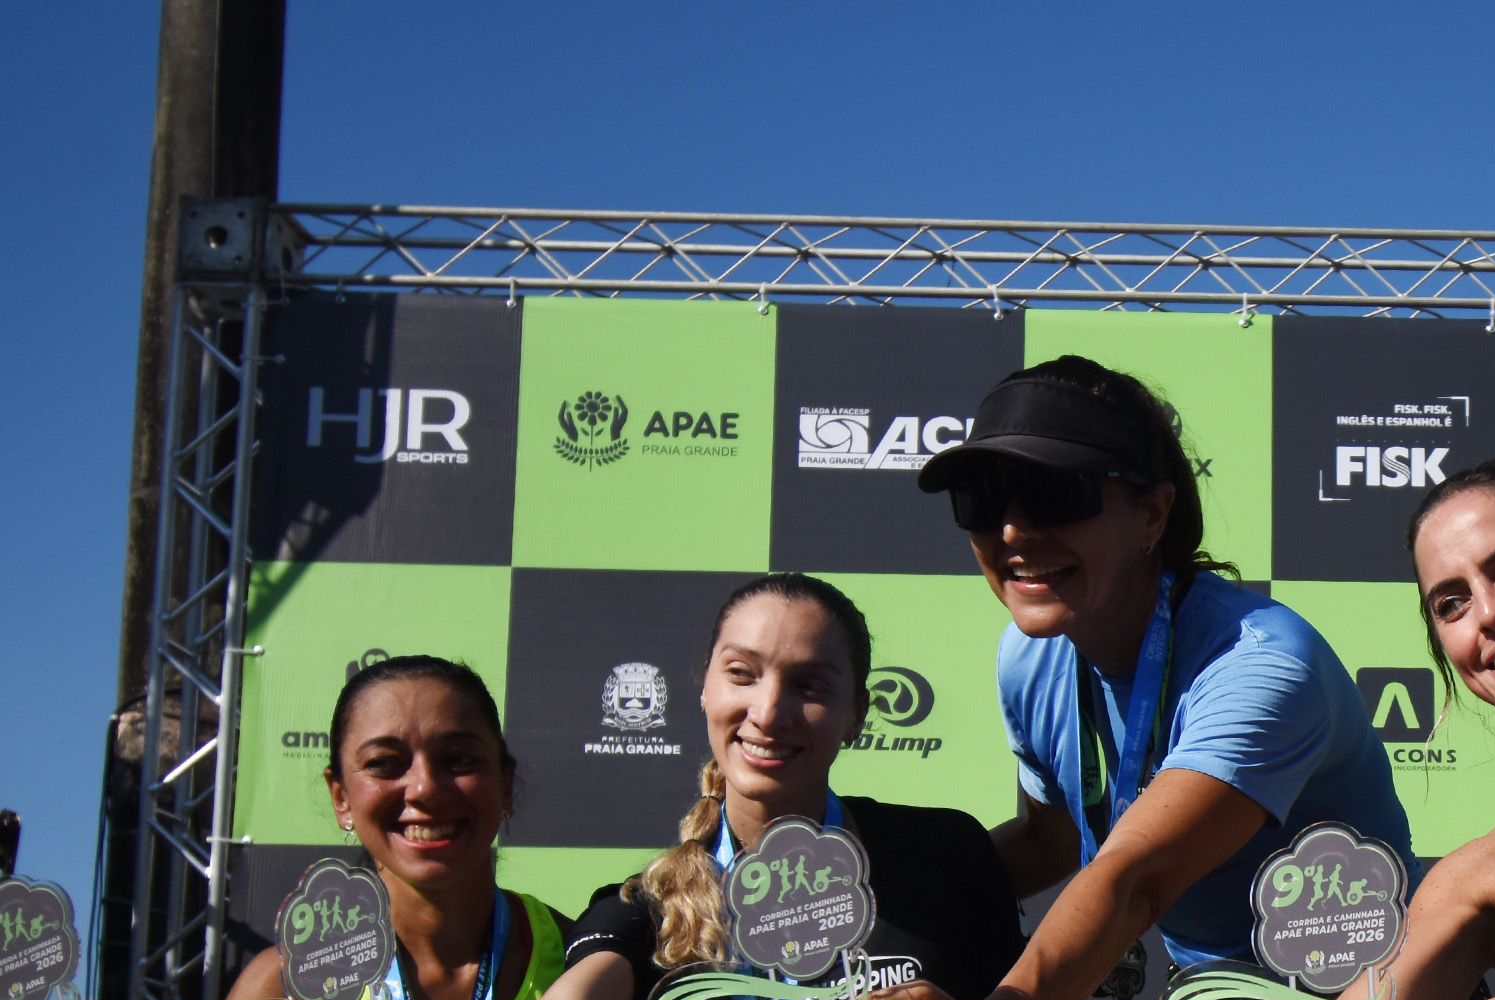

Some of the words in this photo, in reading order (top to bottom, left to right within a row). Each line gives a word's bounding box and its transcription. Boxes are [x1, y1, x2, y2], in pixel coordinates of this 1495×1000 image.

[1395, 404, 1422, 414] FISK.
[1424, 405, 1452, 414] FISK.
[307, 386, 470, 463] HJR
[643, 411, 739, 439] APAE
[1337, 415, 1375, 425] INGLÊS
[1377, 417, 1383, 425] E
[1386, 417, 1443, 426] ESPANHOL
[1445, 416, 1452, 426] É
[397, 453, 468, 463] SPORTS
[642, 445, 680, 455] PRAIA
[684, 446, 738, 456] GRANDE
[829, 457, 865, 465] GRANDE
[1337, 446, 1449, 487] FISK
[585, 744, 624, 753] PRAIA
[626, 745, 680, 754] GRANDE
[1394, 749, 1456, 763] CONS
[760, 909, 795, 923] CORRIDA
[804, 893, 852, 911] CAMINHADA
[749, 922, 775, 936] APAE
[778, 913, 809, 928] PRAIA
[812, 901, 853, 919] GRANDE
[818, 912, 854, 931] 2026
[1287, 917, 1324, 928] CORRIDA
[1334, 909, 1385, 922] CAMINHADA
[1274, 928, 1302, 940] APAE
[1305, 924, 1337, 936] PRAIA
[1341, 918, 1385, 932] GRANDE
[1346, 928, 1385, 944] 2026
[24, 935, 60, 955] CAMINHADA
[306, 947, 333, 961] CORRIDA
[340, 929, 376, 948] CAMINHADA
[803, 937, 828, 951] APAE
[5, 958, 28, 973] PRAIA
[30, 942, 62, 962] GRANDE
[36, 951, 63, 971] 2026
[298, 961, 319, 974] APAE
[320, 952, 343, 965] PRAIA
[346, 937, 377, 955] GRANDE
[351, 947, 378, 966] 2026
[1328, 952, 1355, 963] APAE
[26, 976, 45, 991] APAE
[340, 973, 359, 986] APAE
